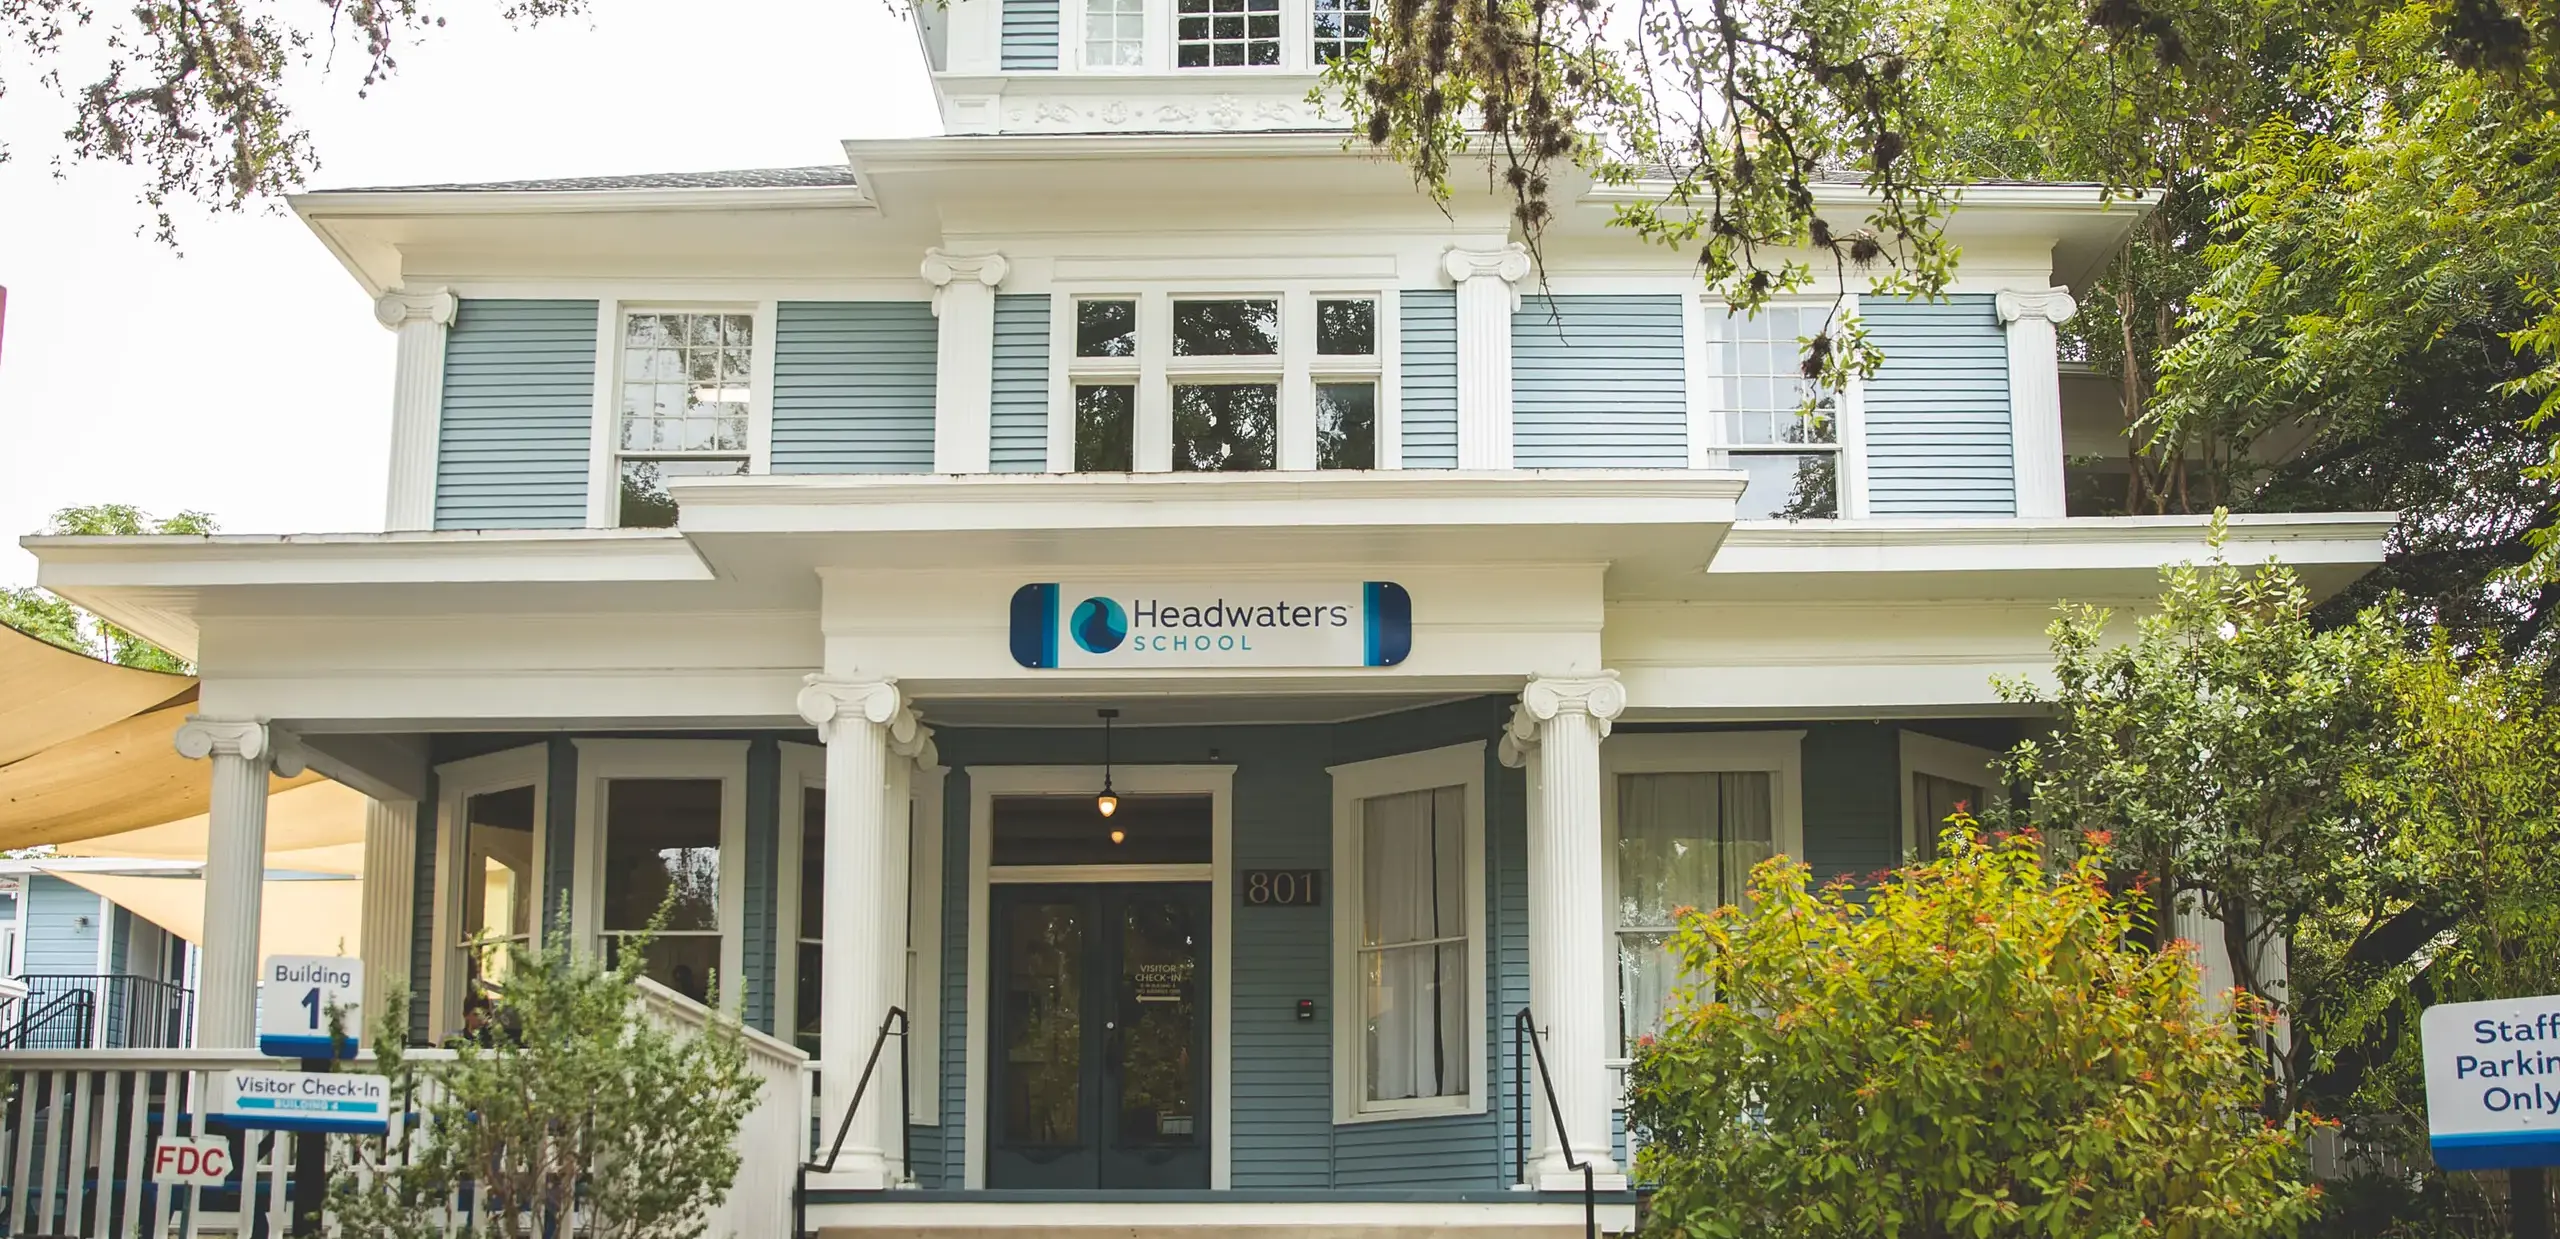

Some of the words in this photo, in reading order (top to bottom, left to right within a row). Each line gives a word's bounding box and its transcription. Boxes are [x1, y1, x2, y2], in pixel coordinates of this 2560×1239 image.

[1134, 599, 1348, 628] Headwaters
[1134, 635, 1252, 651] SCHOOL
[1249, 872, 1312, 904] 801
[275, 965, 351, 988] Building
[1135, 973, 1181, 982] CHECK-IN
[1140, 964, 1177, 973] VISITOR
[301, 987, 320, 1030] 1
[2474, 1013, 2560, 1044] Staff
[236, 1076, 296, 1094] Visitor
[302, 1078, 380, 1097] Check-In
[2483, 1083, 2560, 1115] Only
[156, 1146, 224, 1177] FDC
